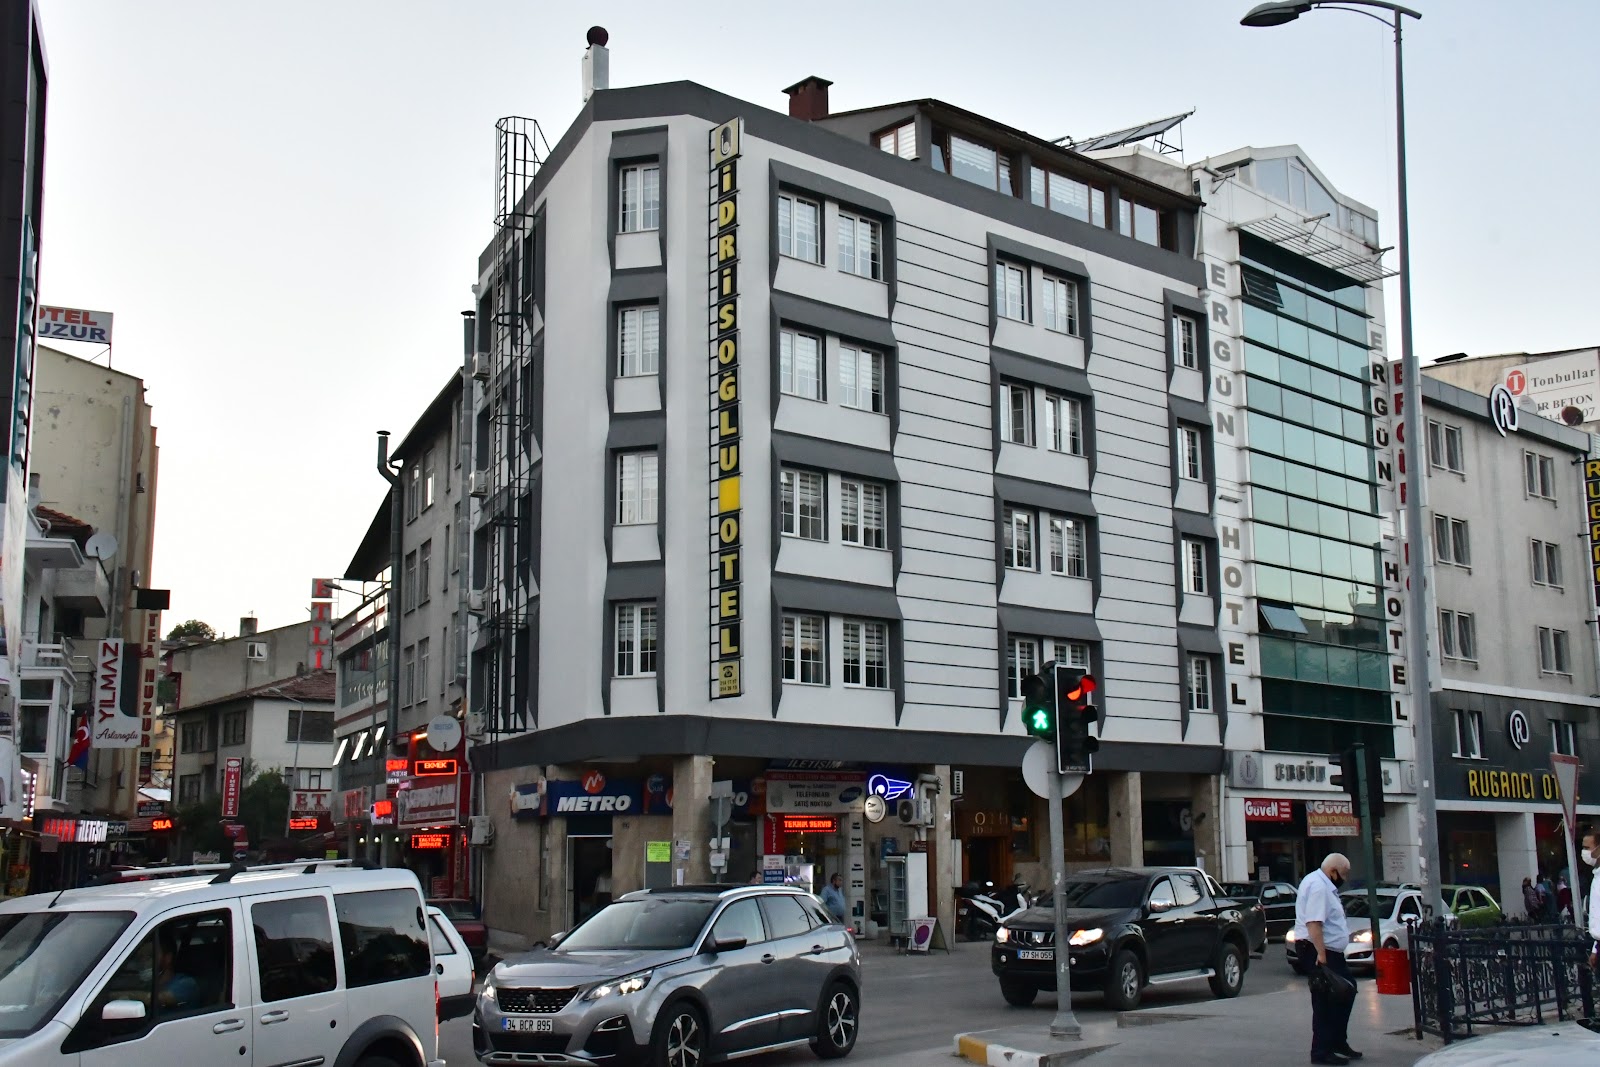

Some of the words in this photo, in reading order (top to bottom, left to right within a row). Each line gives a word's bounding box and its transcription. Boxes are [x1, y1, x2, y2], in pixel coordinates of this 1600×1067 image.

[1210, 264, 1234, 437] ERGÜN
[1531, 368, 1596, 388] Tonbullar
[1370, 330, 1392, 482] ERGÜN
[1552, 394, 1594, 409] BETON
[719, 518, 738, 656] OTEL
[1221, 526, 1247, 706] HOTEL
[1384, 561, 1408, 721] HOTEL
[98, 642, 119, 724] YILMAZ
[424, 762, 447, 770] EKMEK
[1468, 769, 1535, 799] RUGANCI
[557, 794, 632, 812] METRO
[152, 819, 172, 830] SILA
[507, 1019, 515, 1030] 34
[536, 1019, 551, 1031] 895
